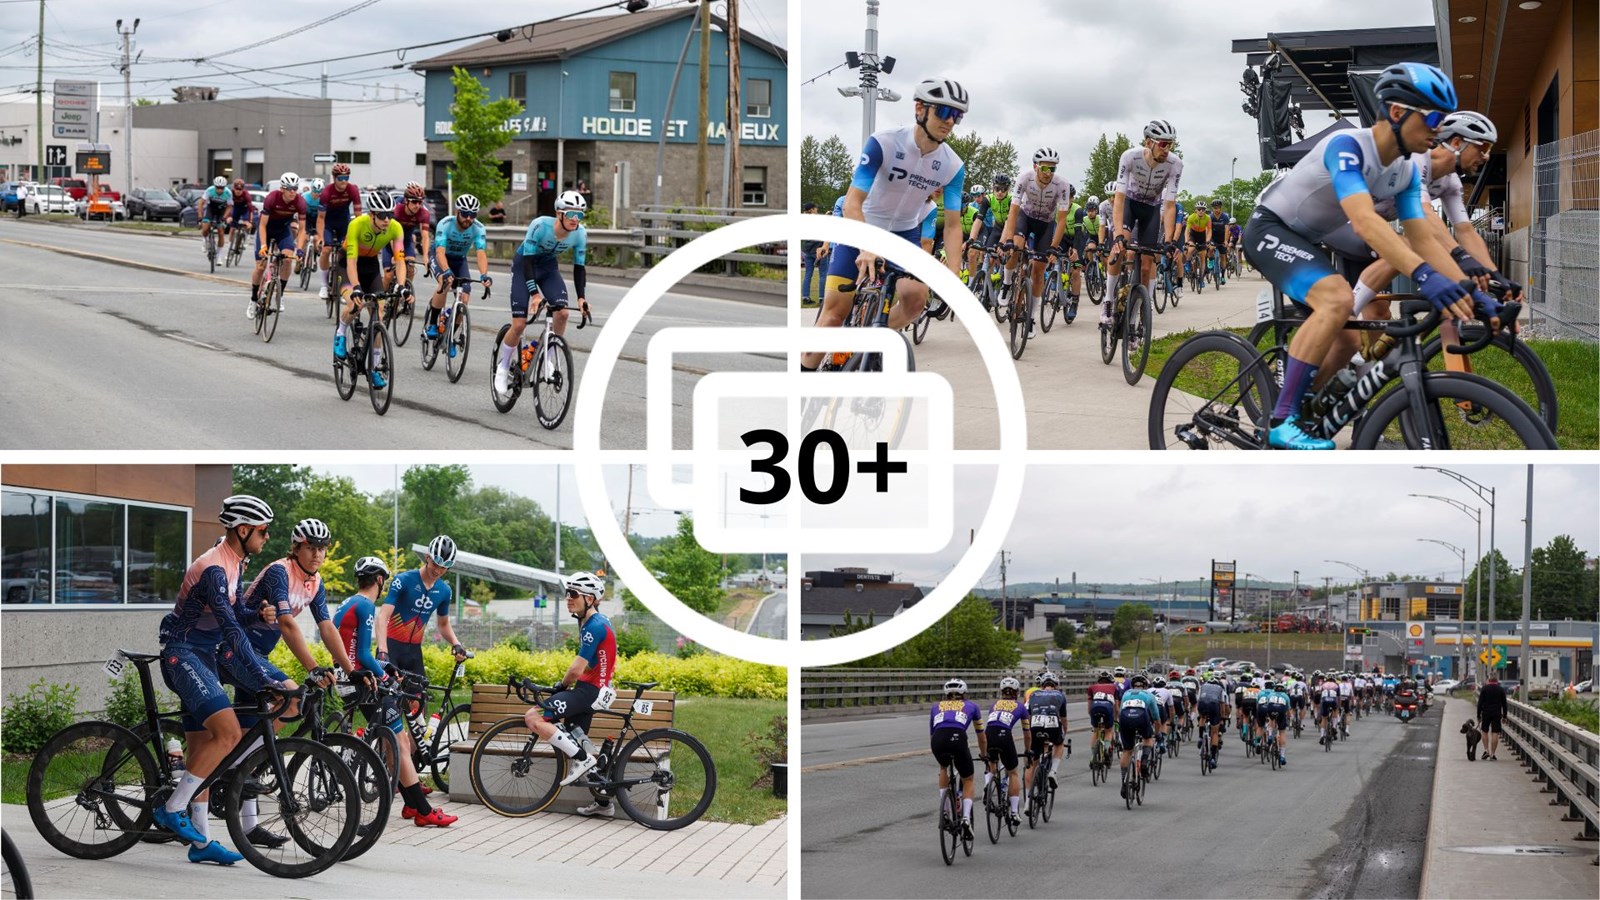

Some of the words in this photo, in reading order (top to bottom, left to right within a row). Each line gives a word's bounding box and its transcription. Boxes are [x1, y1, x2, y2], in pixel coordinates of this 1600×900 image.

[61, 112, 82, 121] Jeep
[582, 116, 651, 136] HOUDE
[908, 180, 928, 191] TECH
[909, 174, 941, 187] PREMIER
[1274, 250, 1296, 263] TECH
[1277, 243, 1315, 261] PREMIER
[1258, 301, 1270, 319] 114
[1311, 360, 1390, 441] ACTOR
[108, 659, 123, 676] 133
[598, 649, 608, 678] CYCLING
[602, 690, 613, 704] 85
[641, 704, 649, 713] 85
